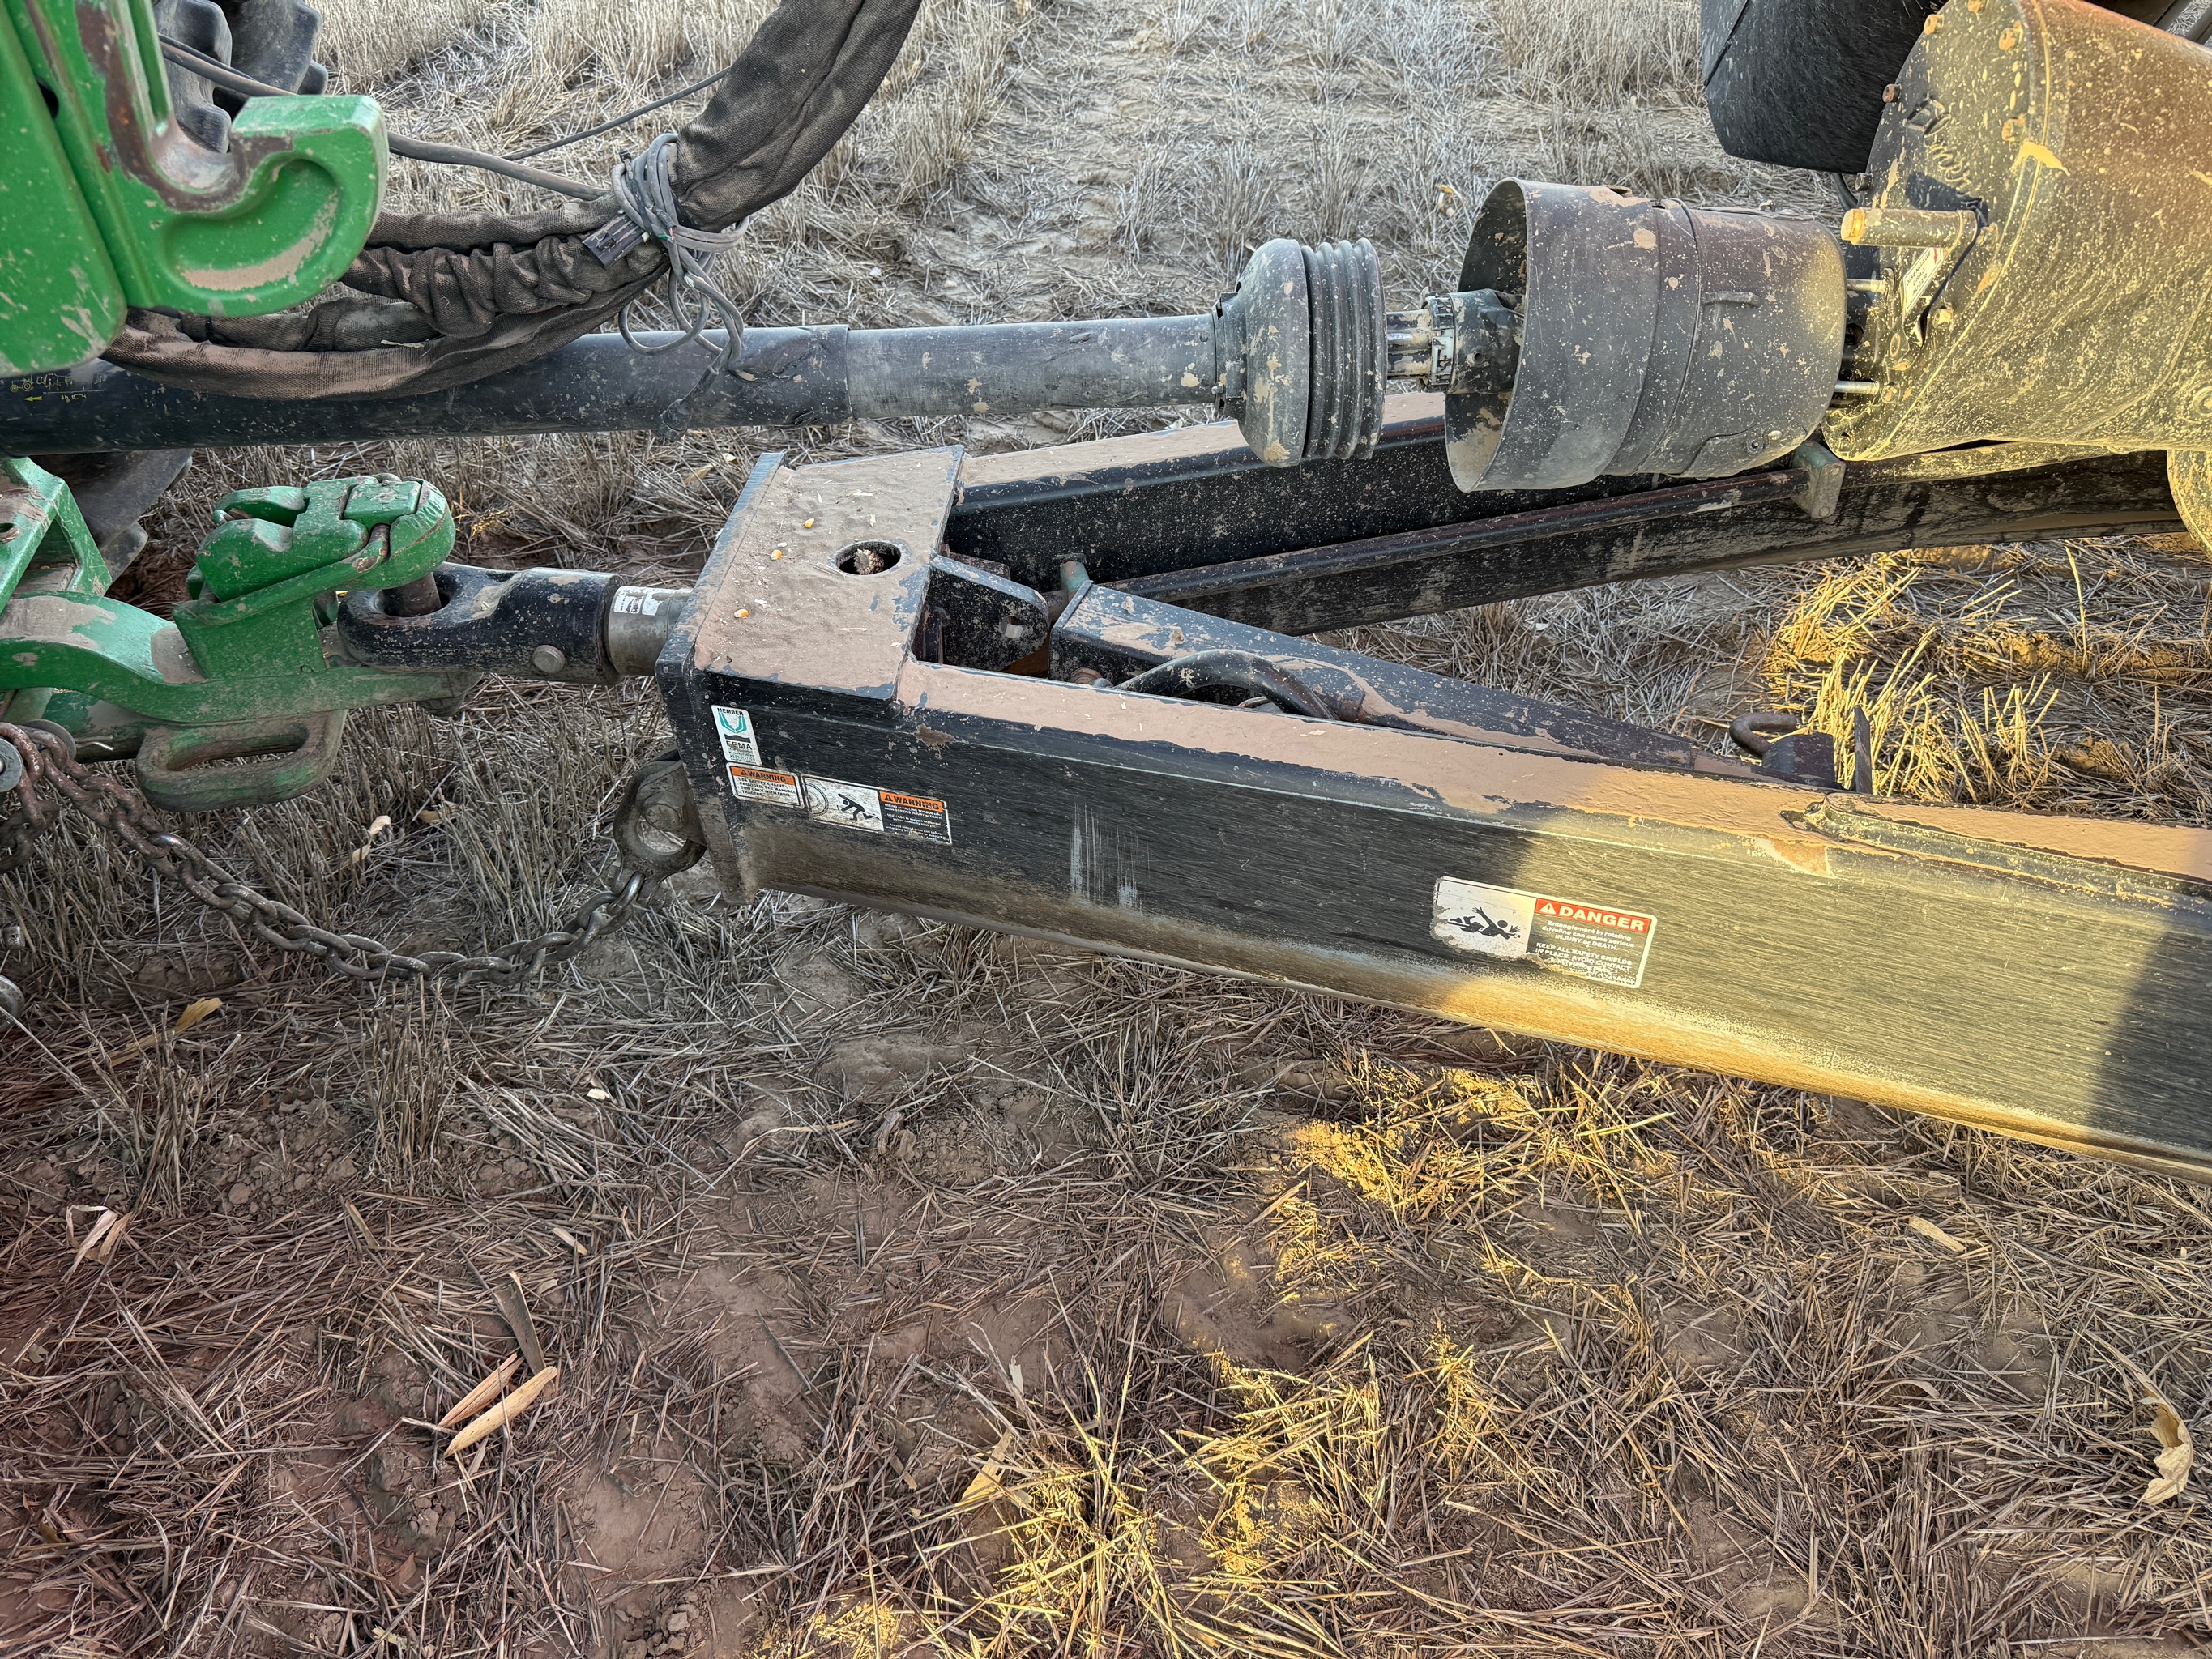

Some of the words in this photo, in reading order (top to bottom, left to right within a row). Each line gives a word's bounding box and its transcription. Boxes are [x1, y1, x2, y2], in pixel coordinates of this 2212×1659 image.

[717, 708, 744, 716] MEMBER
[748, 771, 787, 783] WARNING
[894, 796, 939, 810] WARNING
[1559, 906, 1645, 932] DANGER
[1541, 926, 1571, 936] driveline
[1608, 938, 1635, 948] serious
[1548, 920, 1595, 934] Entanglement
[1604, 932, 1632, 941] rotating
[1555, 934, 1582, 944] INJURY
[1572, 949, 1600, 960] SAFETY
[1601, 955, 1633, 966] SHIELDS
[1596, 960, 1632, 971] CONTACT
